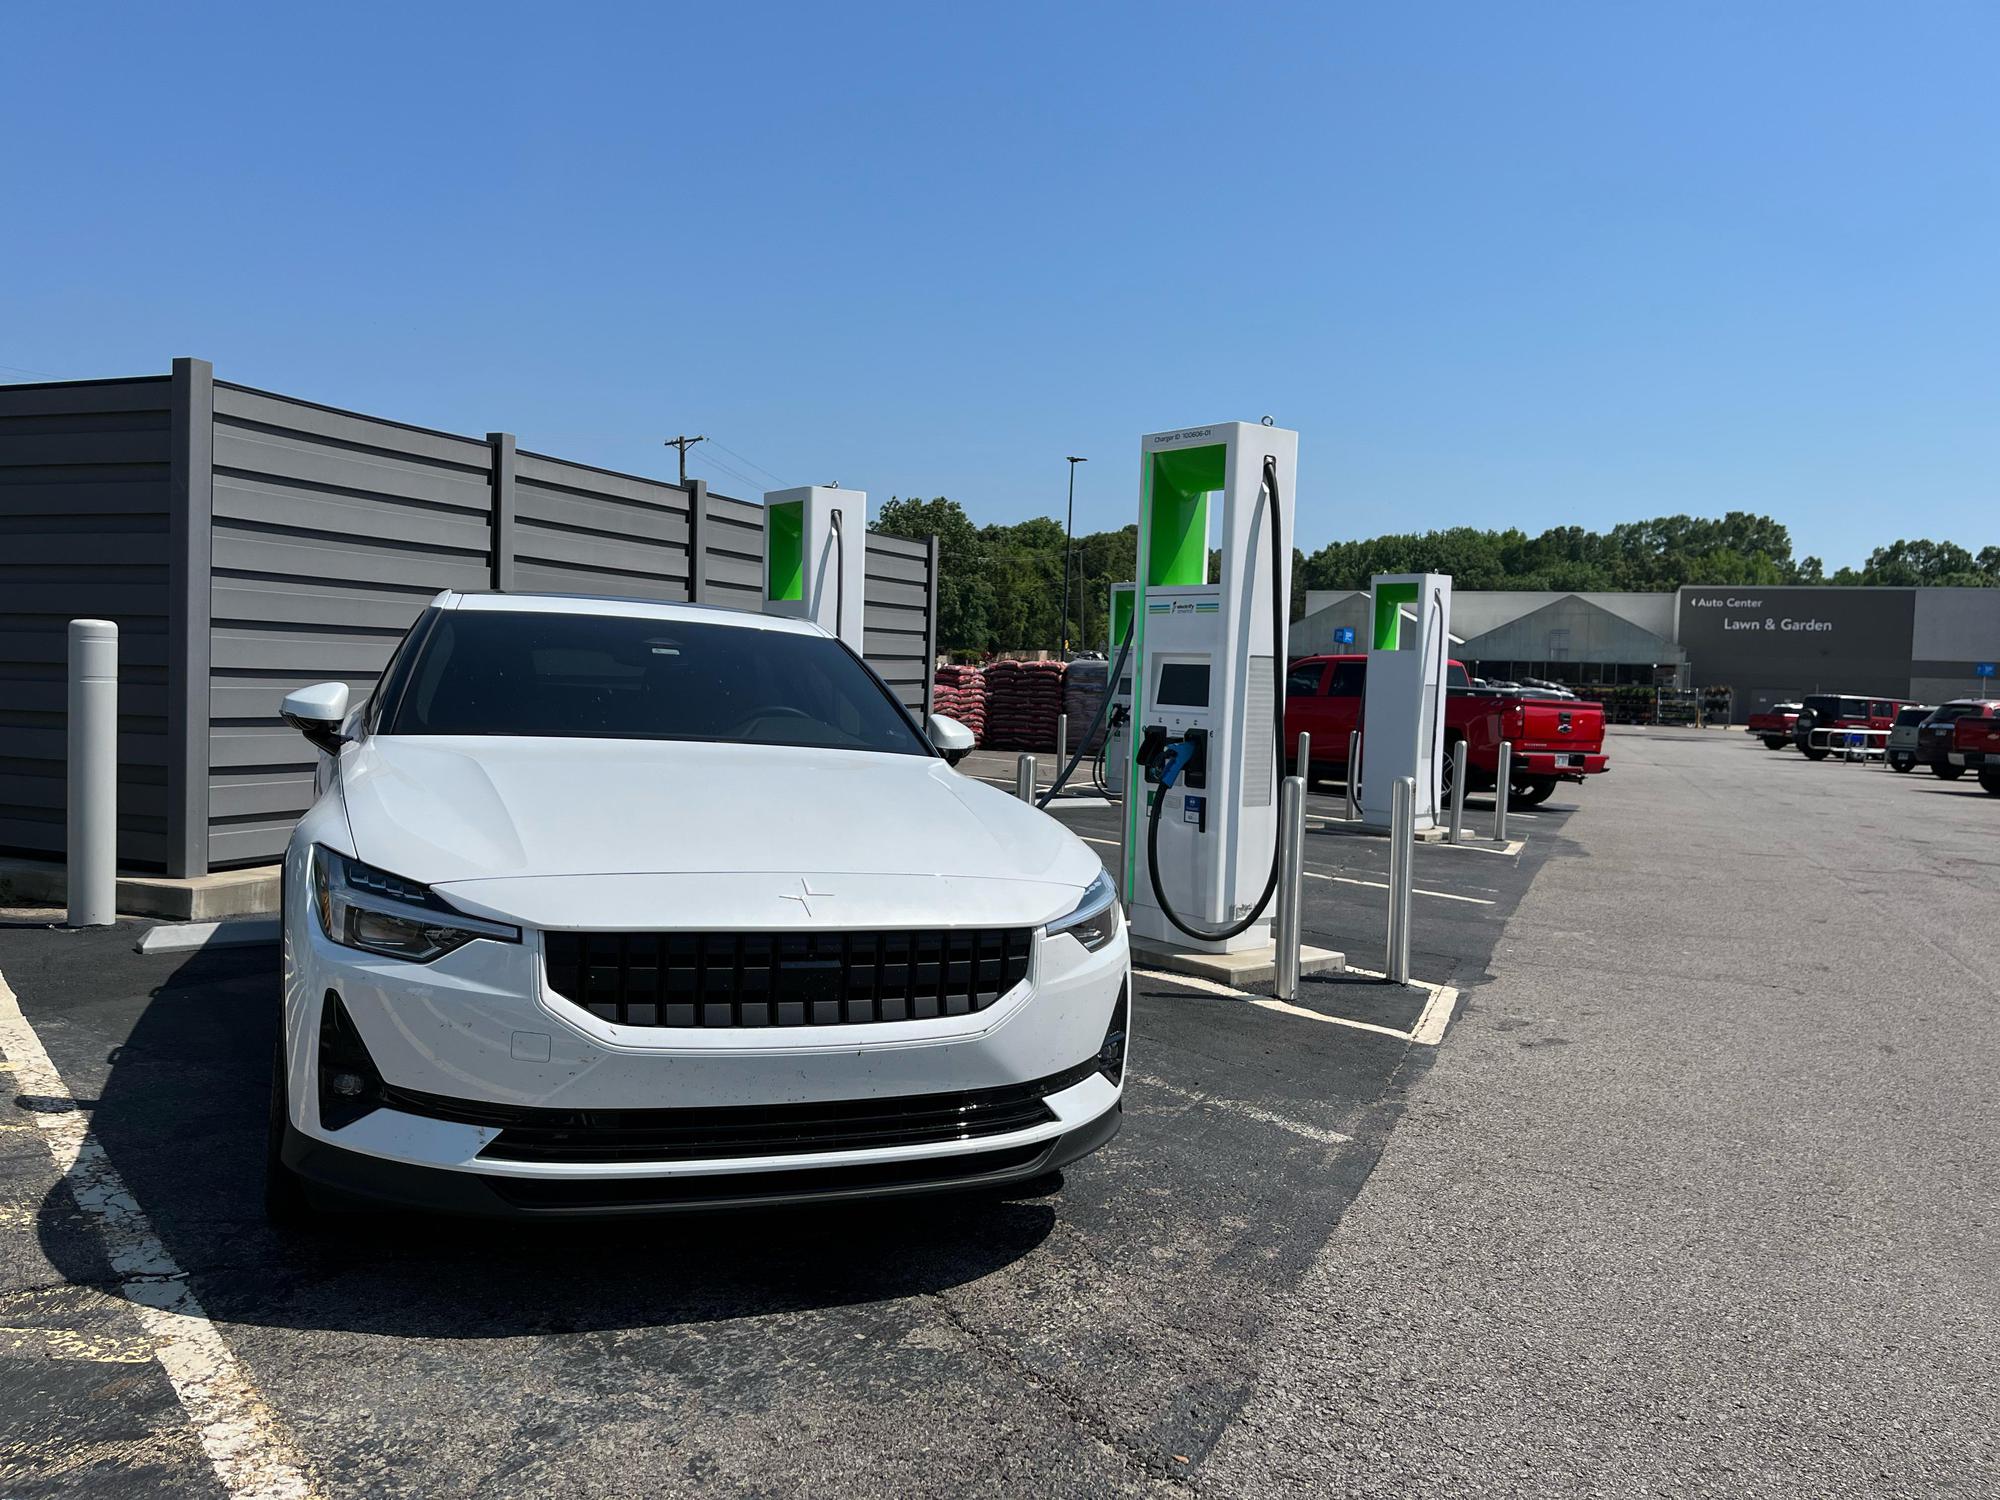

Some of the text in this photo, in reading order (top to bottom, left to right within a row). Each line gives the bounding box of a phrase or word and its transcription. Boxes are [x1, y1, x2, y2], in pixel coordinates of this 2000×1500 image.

[1697, 597, 1763, 608] Auto Center
[1724, 617, 1833, 632] Lawn & Garden
